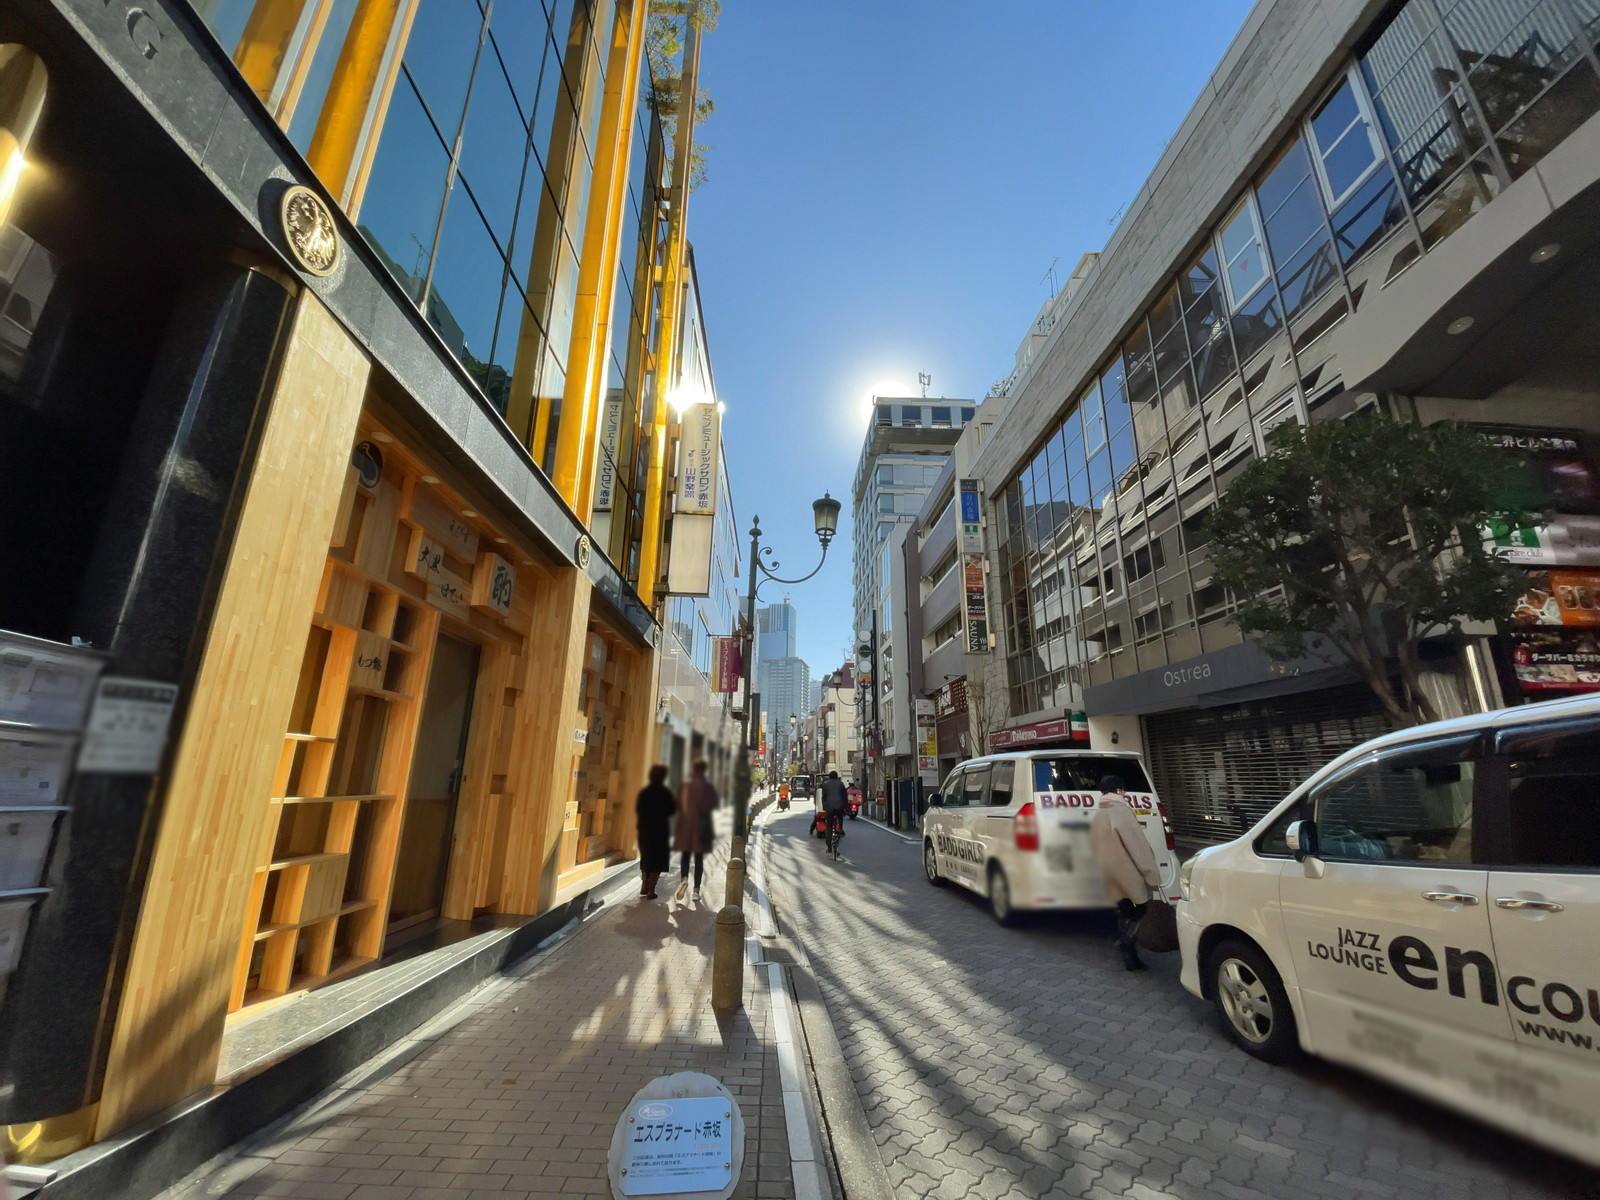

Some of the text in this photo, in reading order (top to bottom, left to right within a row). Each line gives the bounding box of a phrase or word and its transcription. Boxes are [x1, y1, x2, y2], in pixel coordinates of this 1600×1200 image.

[698, 407, 714, 509] ヤマノミュージックサロン赤坂
[969, 620, 979, 651] SAUNA
[1163, 663, 1211, 687] Ostrea
[1040, 794, 1153, 809] BADD RLS
[938, 834, 984, 865] BADD GIRLS
[1338, 927, 1381, 951] JAZZ
[1307, 941, 1388, 975] LOUNGE
[634, 1120, 722, 1143] エスプラナード赤坂
